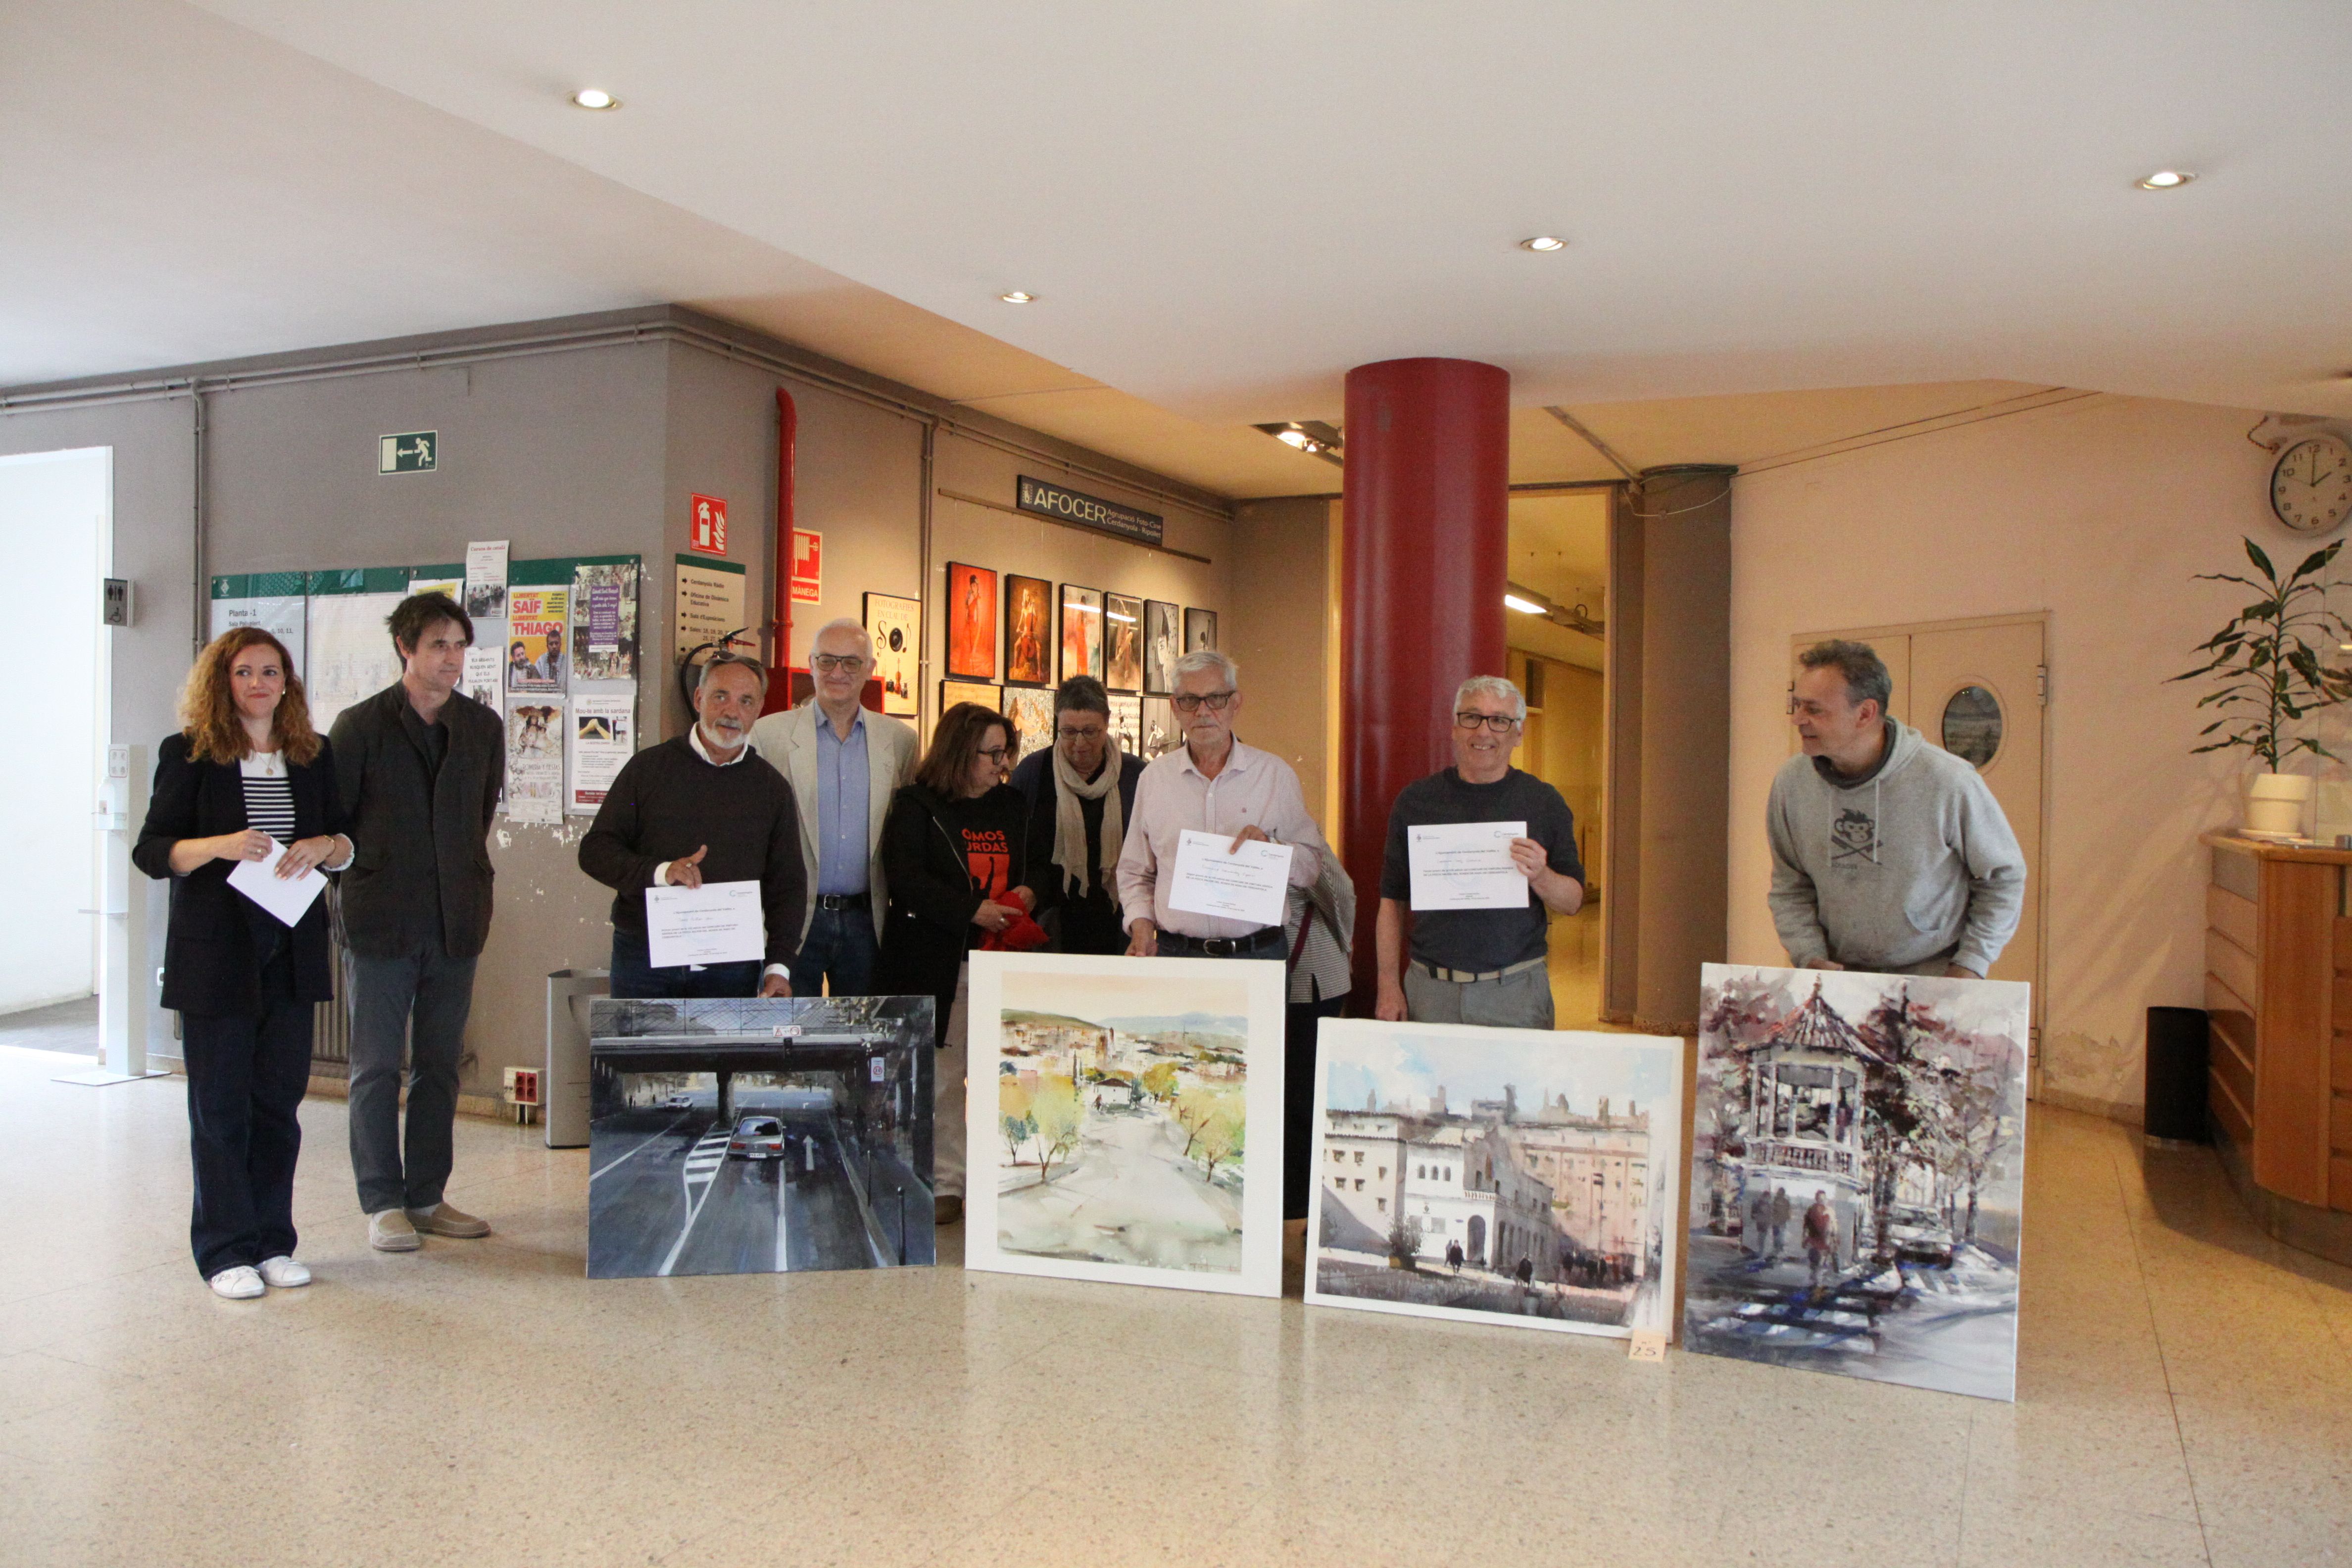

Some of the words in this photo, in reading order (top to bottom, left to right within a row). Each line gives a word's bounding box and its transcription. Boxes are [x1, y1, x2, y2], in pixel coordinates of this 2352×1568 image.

[2338, 458, 2346, 467] 2
[2283, 468, 2295, 477] 10
[1034, 488, 1107, 524] AFOCER
[2328, 509, 2336, 517] 5
[1107, 509, 1135, 523] Agrupació
[1136, 514, 1161, 530] Foto-Cine
[1107, 517, 1138, 532] Cerdanyola
[1141, 528, 1161, 538] Ripollet
[792, 586, 818, 597] MÀNEGA
[513, 598, 541, 613] SAÏF
[875, 599, 915, 612] FOTOGRAFIES
[885, 611, 900, 620] CLAU
[512, 622, 563, 635] THIAGO
[962, 828, 1005, 840] OMOS
[1633, 1346, 1656, 1356] 25
